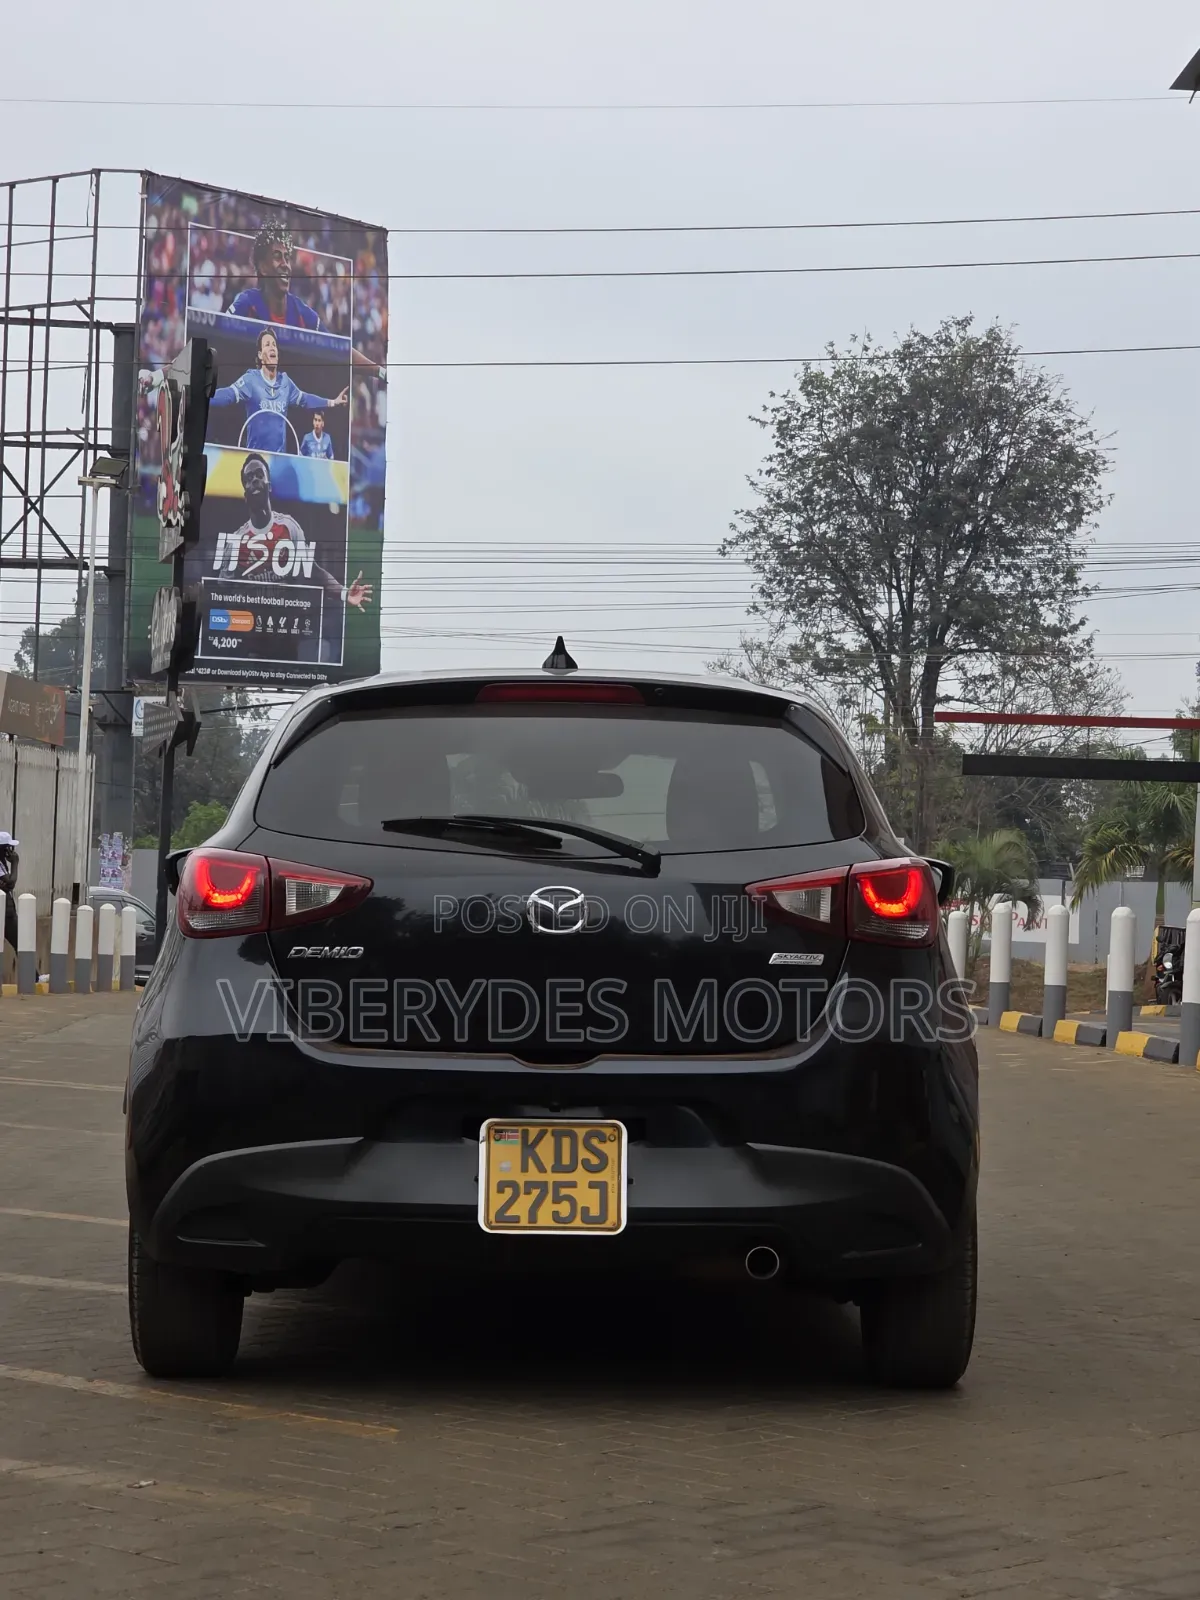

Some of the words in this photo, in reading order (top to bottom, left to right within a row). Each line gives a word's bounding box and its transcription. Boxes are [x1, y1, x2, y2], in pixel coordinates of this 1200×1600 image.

[213, 532, 273, 576] IT'S
[272, 539, 316, 578] ON
[211, 592, 222, 601] The
[223, 594, 246, 603] world's
[247, 595, 260, 604] best
[261, 596, 284, 606] football
[284, 599, 311, 610] package
[213, 637, 238, 649] 4,200
[217, 668, 241, 676] Download
[241, 669, 260, 678] MyDStv
[286, 672, 311, 680] Connected
[287, 946, 364, 958] DEMIO
[521, 1128, 609, 1174] KDS
[495, 1180, 608, 1224] 275J
